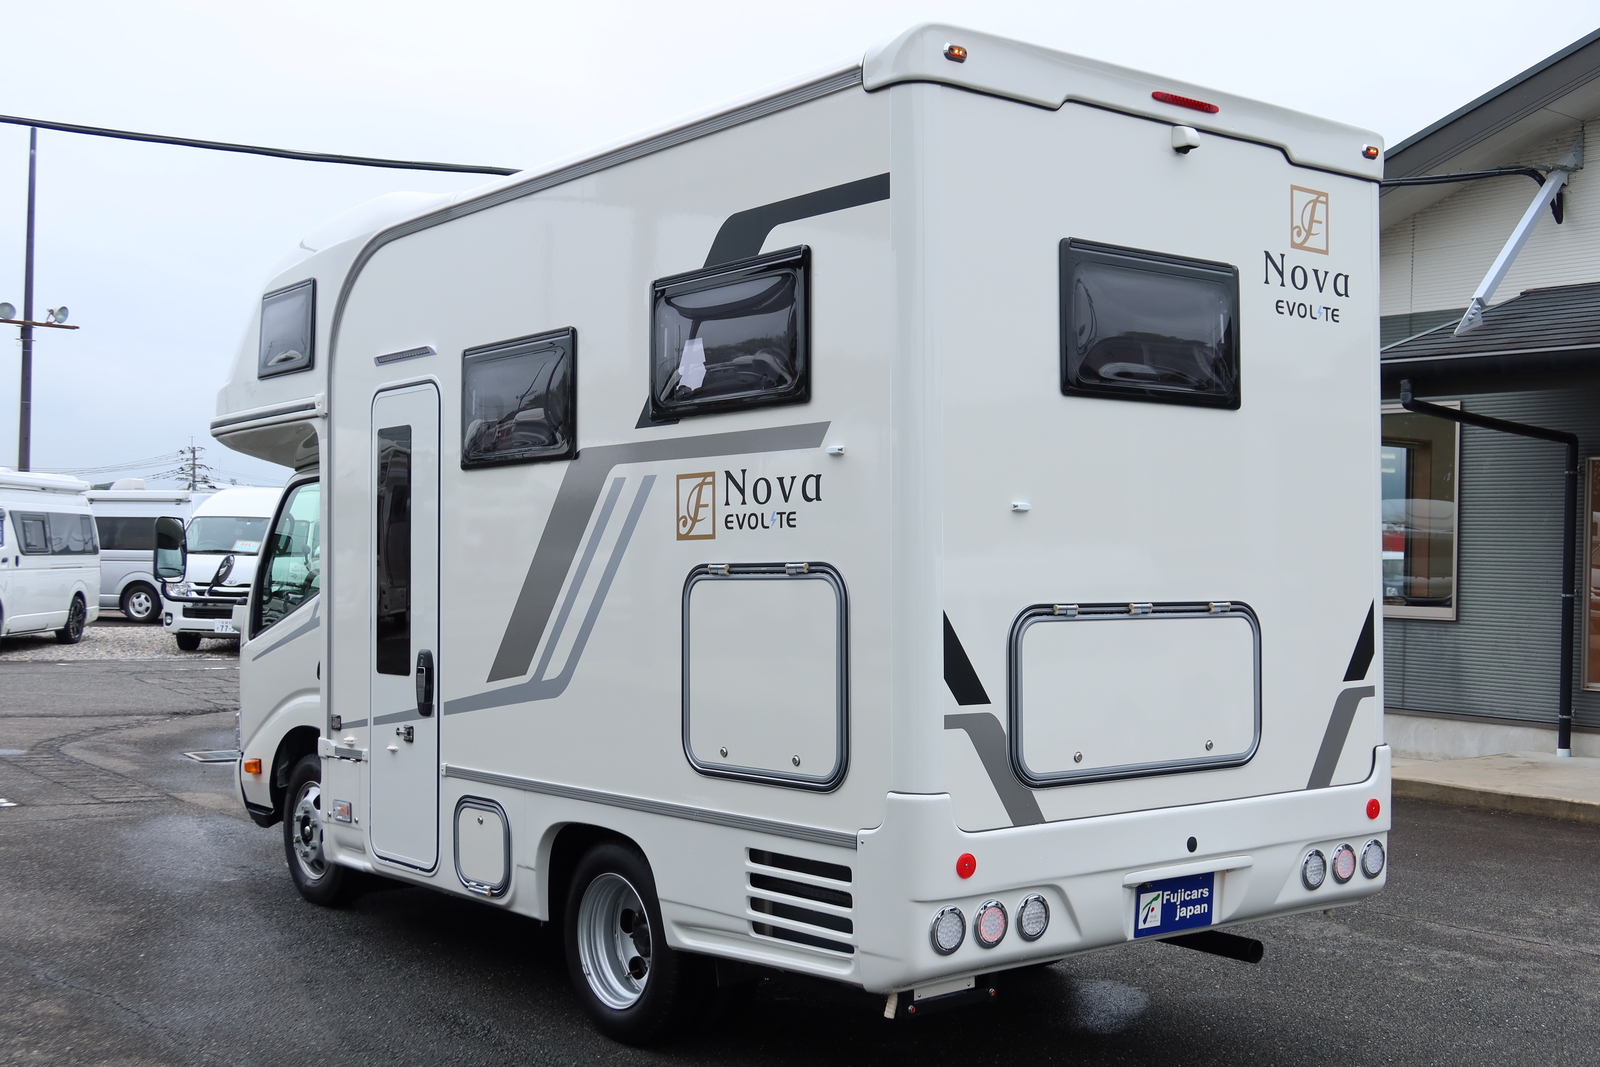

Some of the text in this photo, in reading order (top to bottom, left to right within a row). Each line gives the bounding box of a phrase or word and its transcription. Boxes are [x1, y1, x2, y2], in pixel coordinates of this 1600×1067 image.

[1264, 250, 1350, 298] Nova
[724, 468, 822, 506] Nova
[1163, 887, 1209, 905] Fujicars
[1175, 903, 1208, 921] japan
